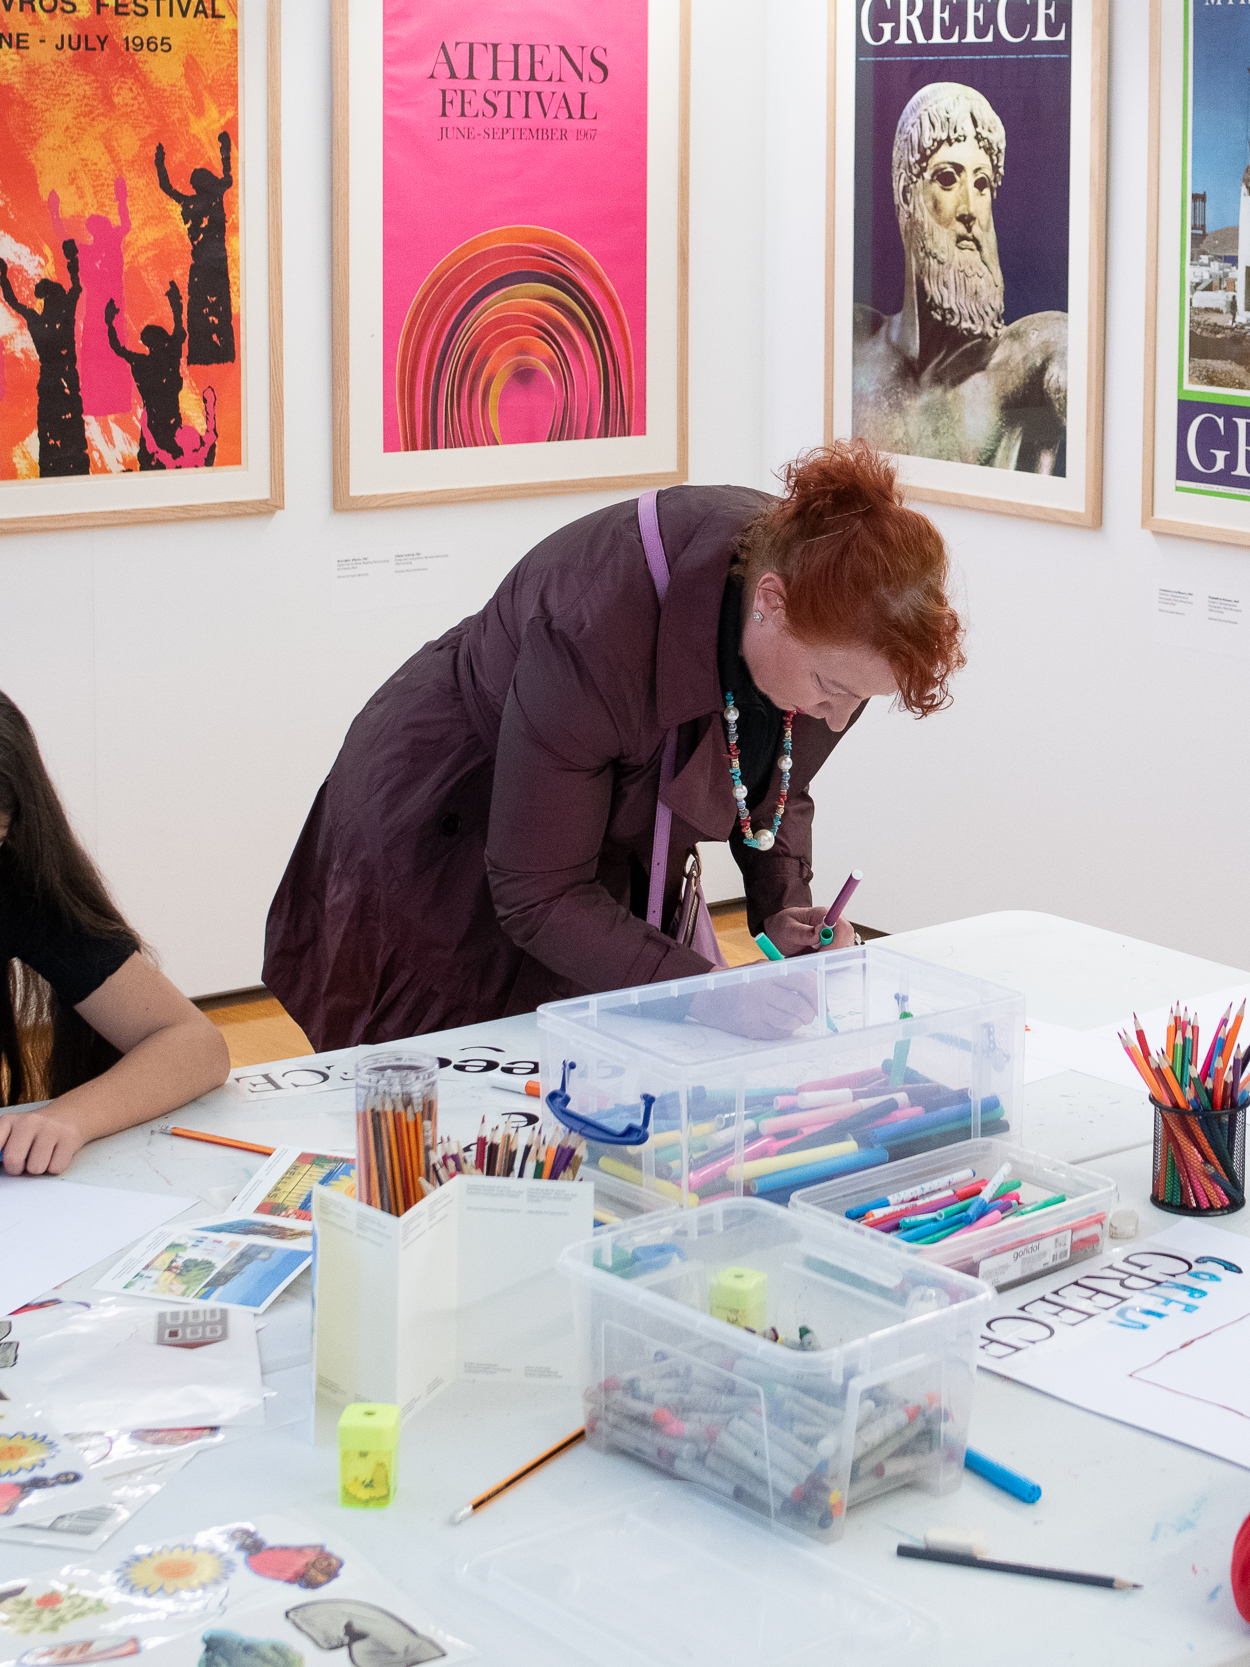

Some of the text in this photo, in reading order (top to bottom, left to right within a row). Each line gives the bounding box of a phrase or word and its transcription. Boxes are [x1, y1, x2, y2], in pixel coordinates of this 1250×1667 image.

[96, 0, 226, 19] FESTIVAL
[860, 0, 1067, 46] GREECE
[55, 34, 109, 51] JULY
[124, 35, 173, 53] 1965
[427, 41, 609, 84] ATHENS
[438, 88, 598, 120] FESTIVAL
[576, 128, 598, 141] 1967
